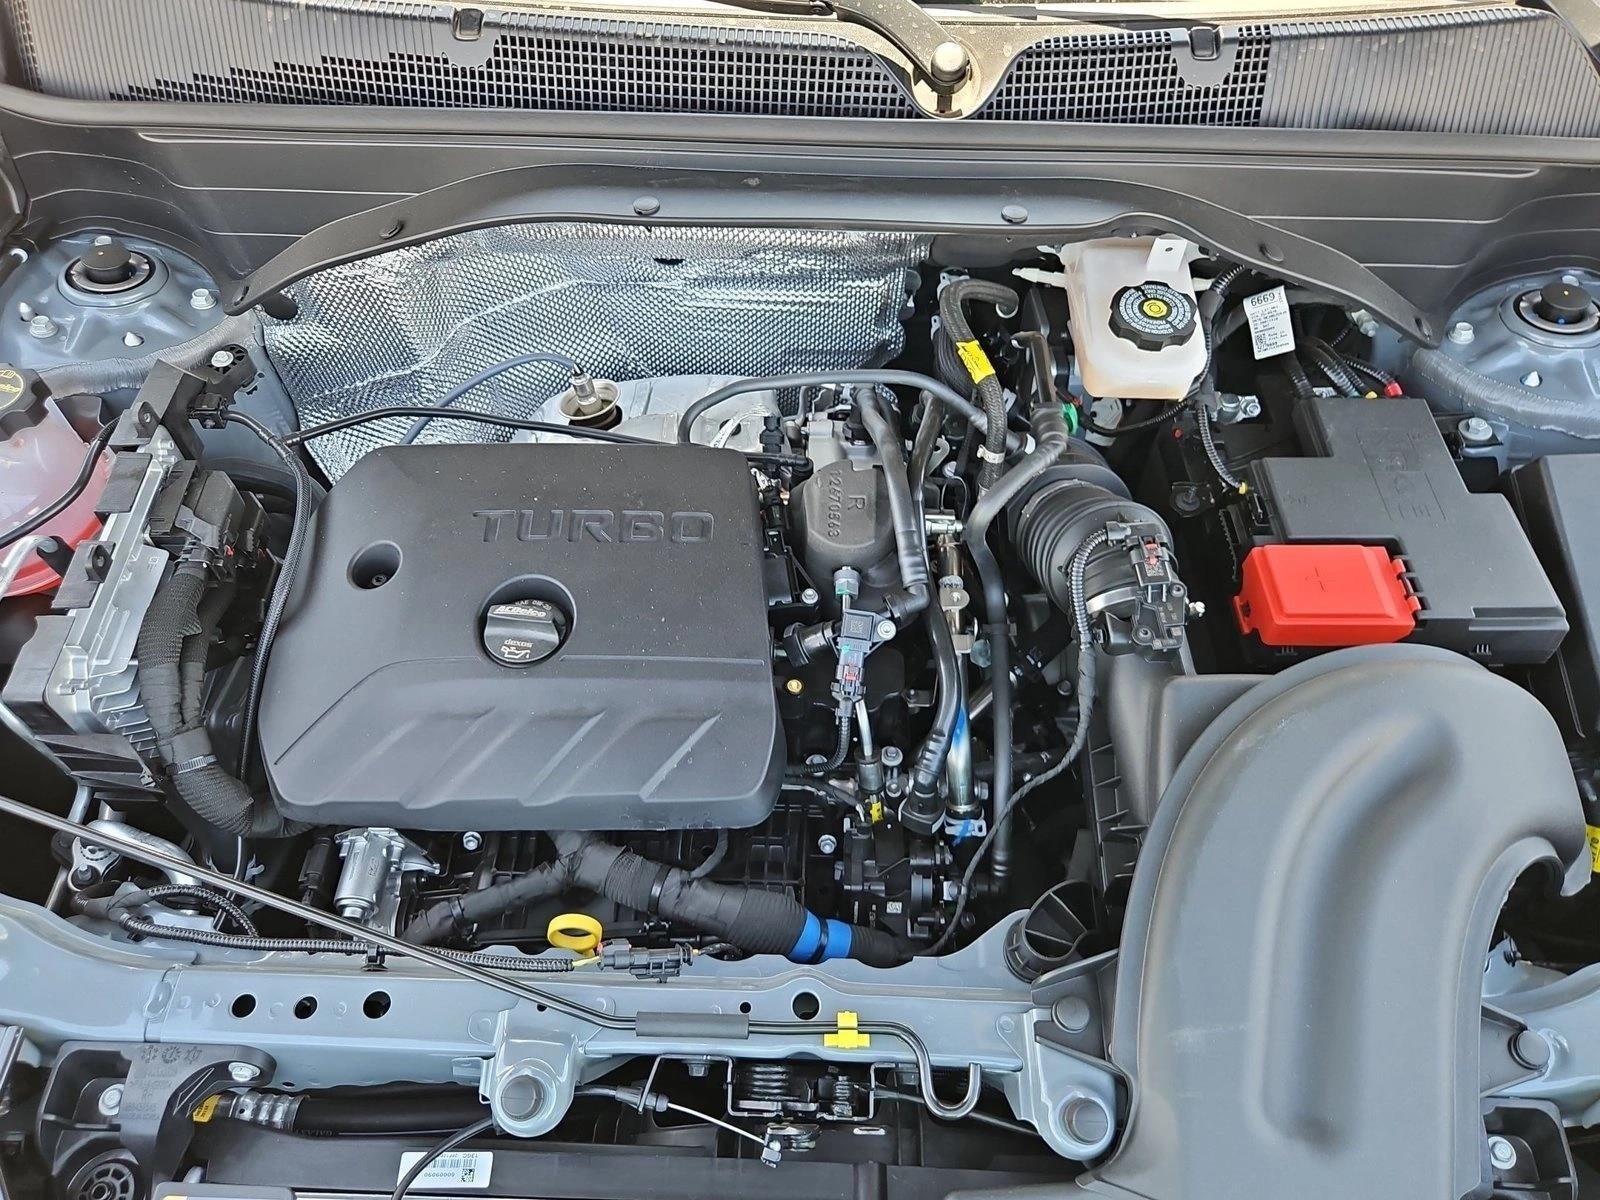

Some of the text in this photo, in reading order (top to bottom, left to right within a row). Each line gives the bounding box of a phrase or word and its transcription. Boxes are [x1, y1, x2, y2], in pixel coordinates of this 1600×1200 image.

[1251, 292, 1276, 307] 6669
[848, 494, 867, 511] R
[472, 509, 715, 544] TURBO
[493, 605, 546, 618] ACDelco
[504, 639, 533, 648] dexos
